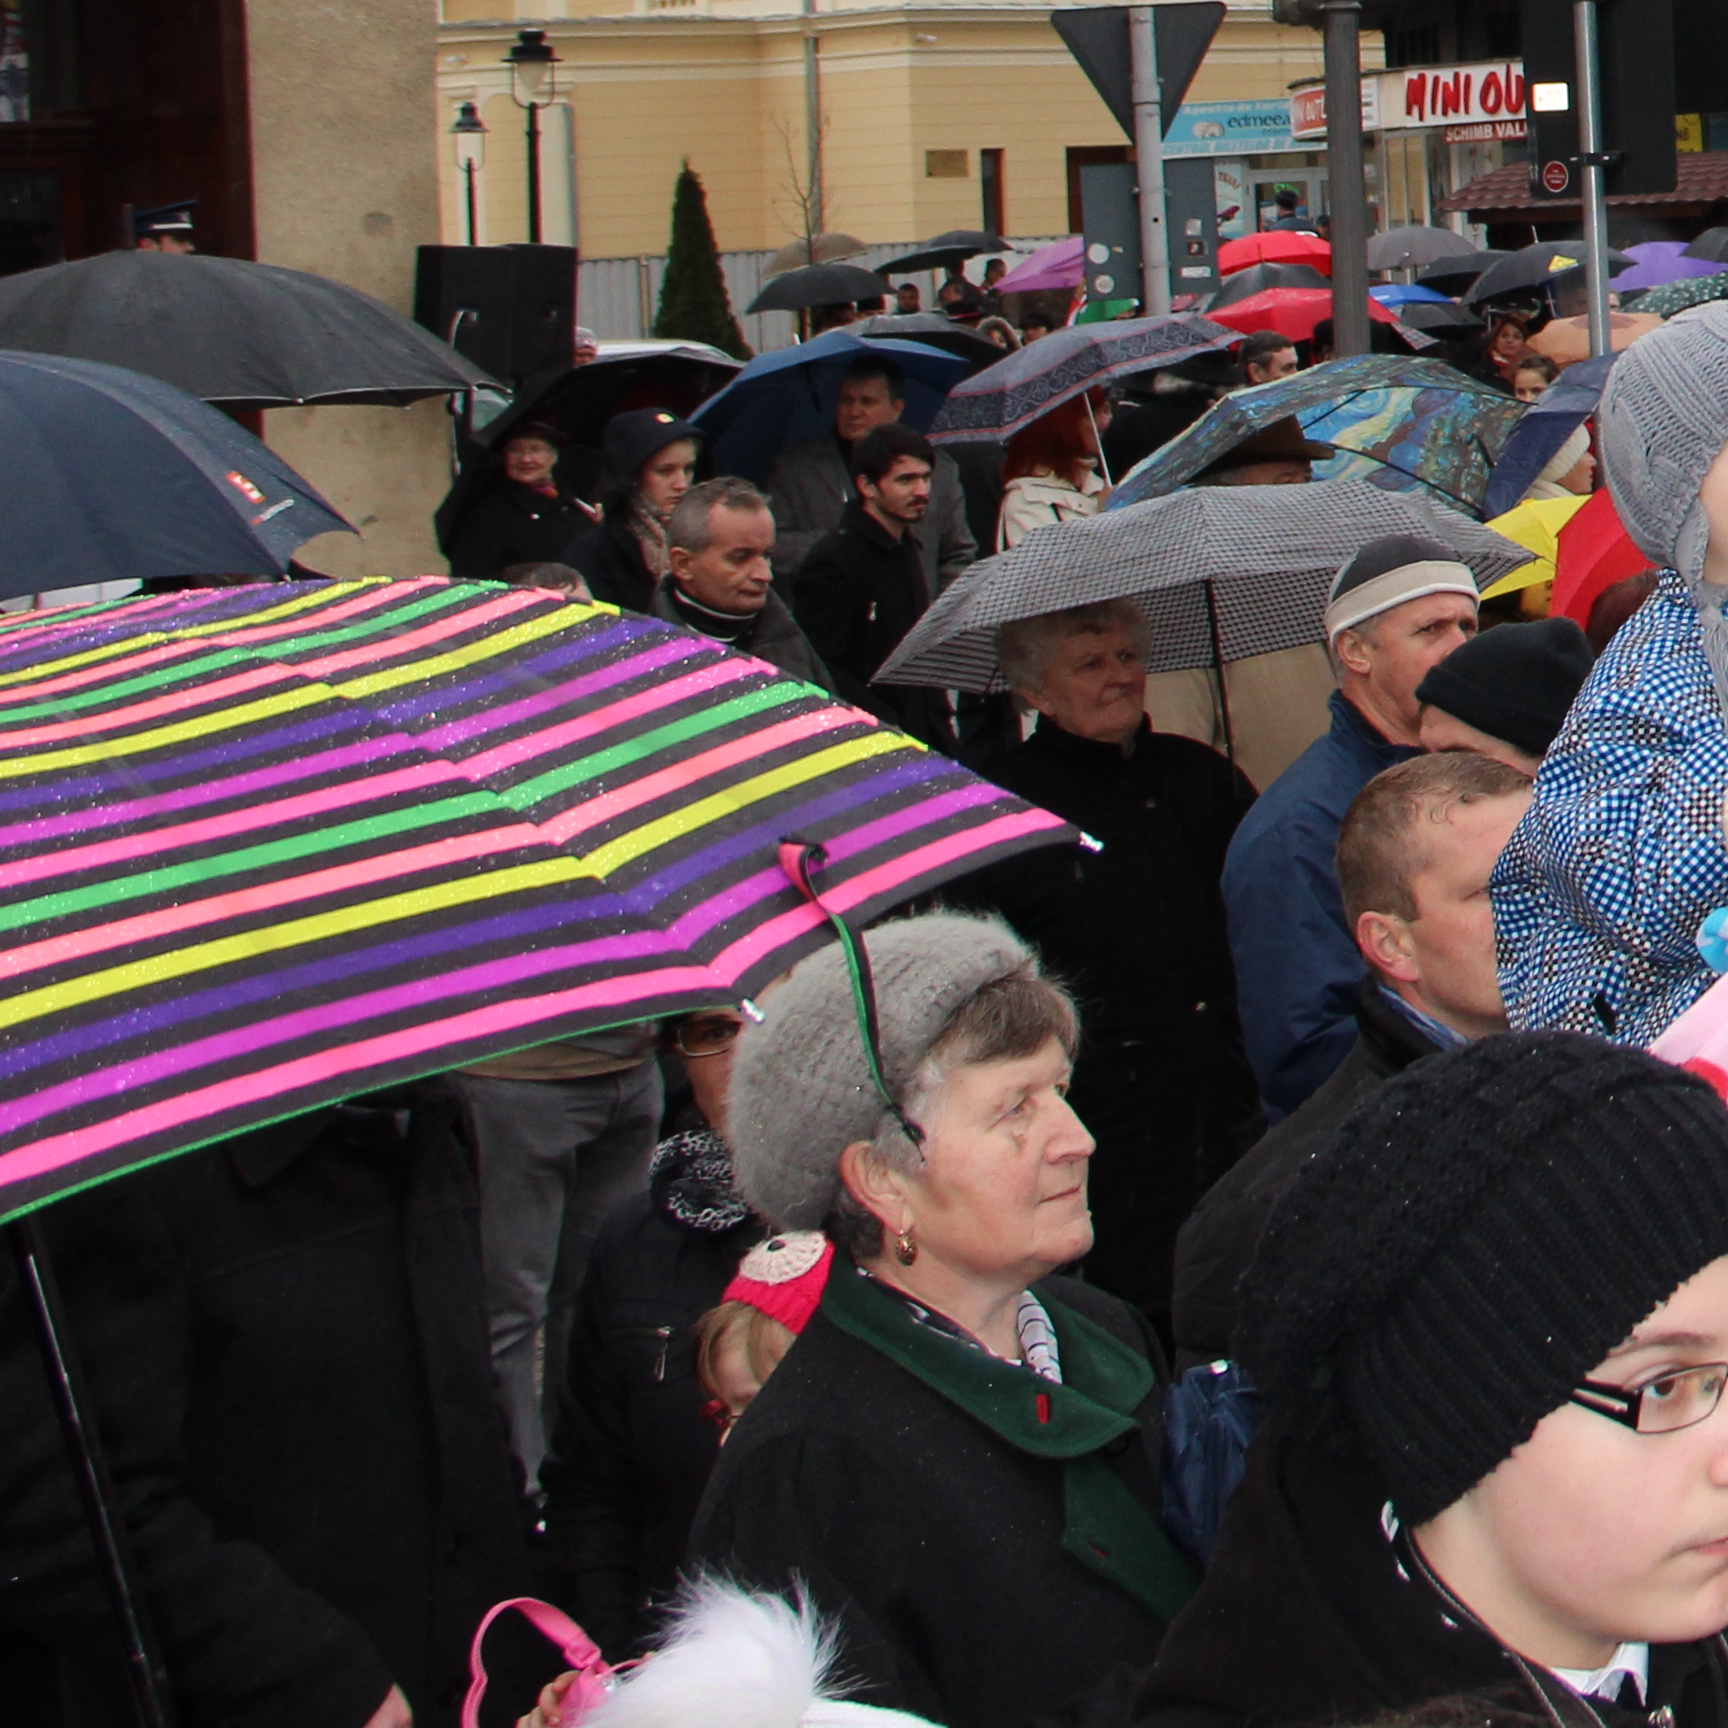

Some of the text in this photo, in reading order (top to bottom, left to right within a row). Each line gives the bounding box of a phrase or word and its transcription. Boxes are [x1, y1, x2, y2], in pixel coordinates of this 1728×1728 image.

[1406, 71, 1472, 122] MINI
[1479, 63, 1526, 115] OU
[1446, 122, 1527, 142] SCHIMB VAL
